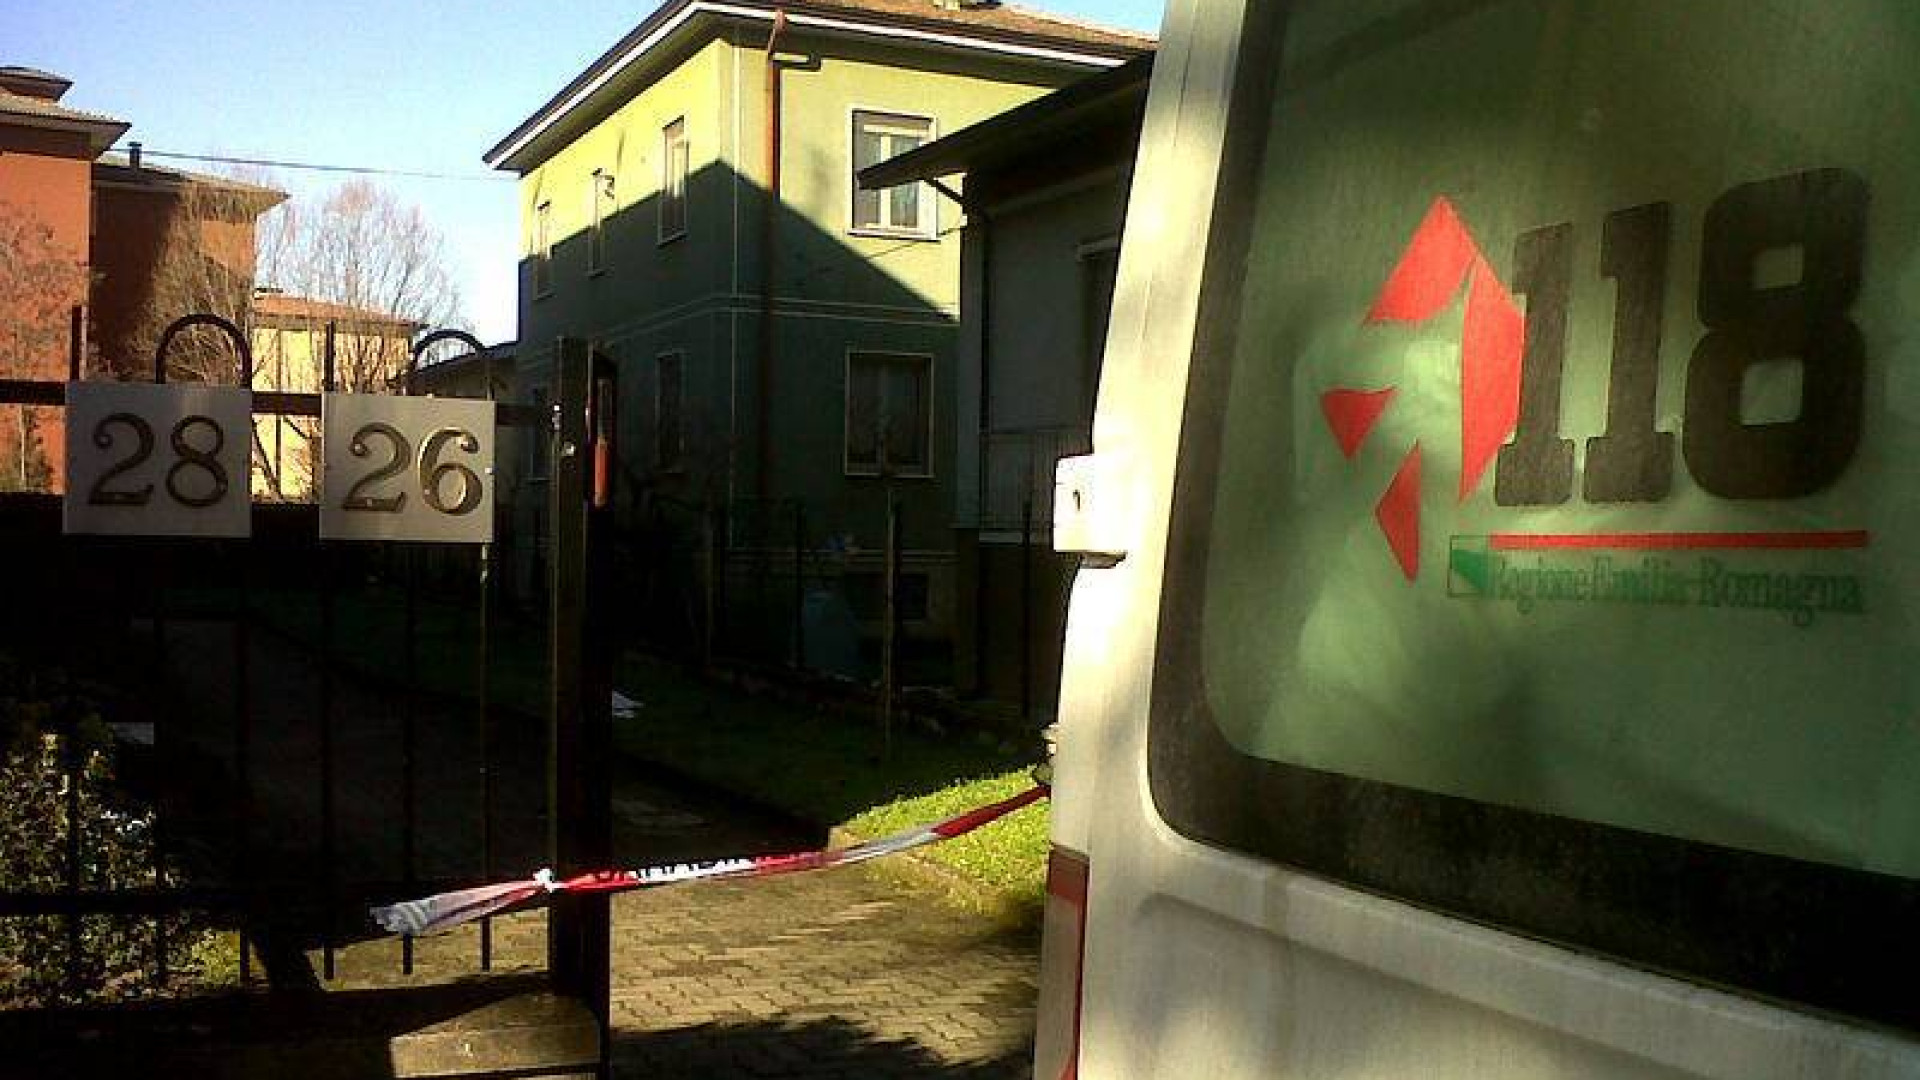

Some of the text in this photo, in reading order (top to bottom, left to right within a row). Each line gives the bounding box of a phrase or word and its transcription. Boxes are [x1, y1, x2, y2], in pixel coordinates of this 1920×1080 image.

[1495, 166, 1870, 506] 118
[89, 411, 229, 507] 28
[342, 422, 483, 516] 26
